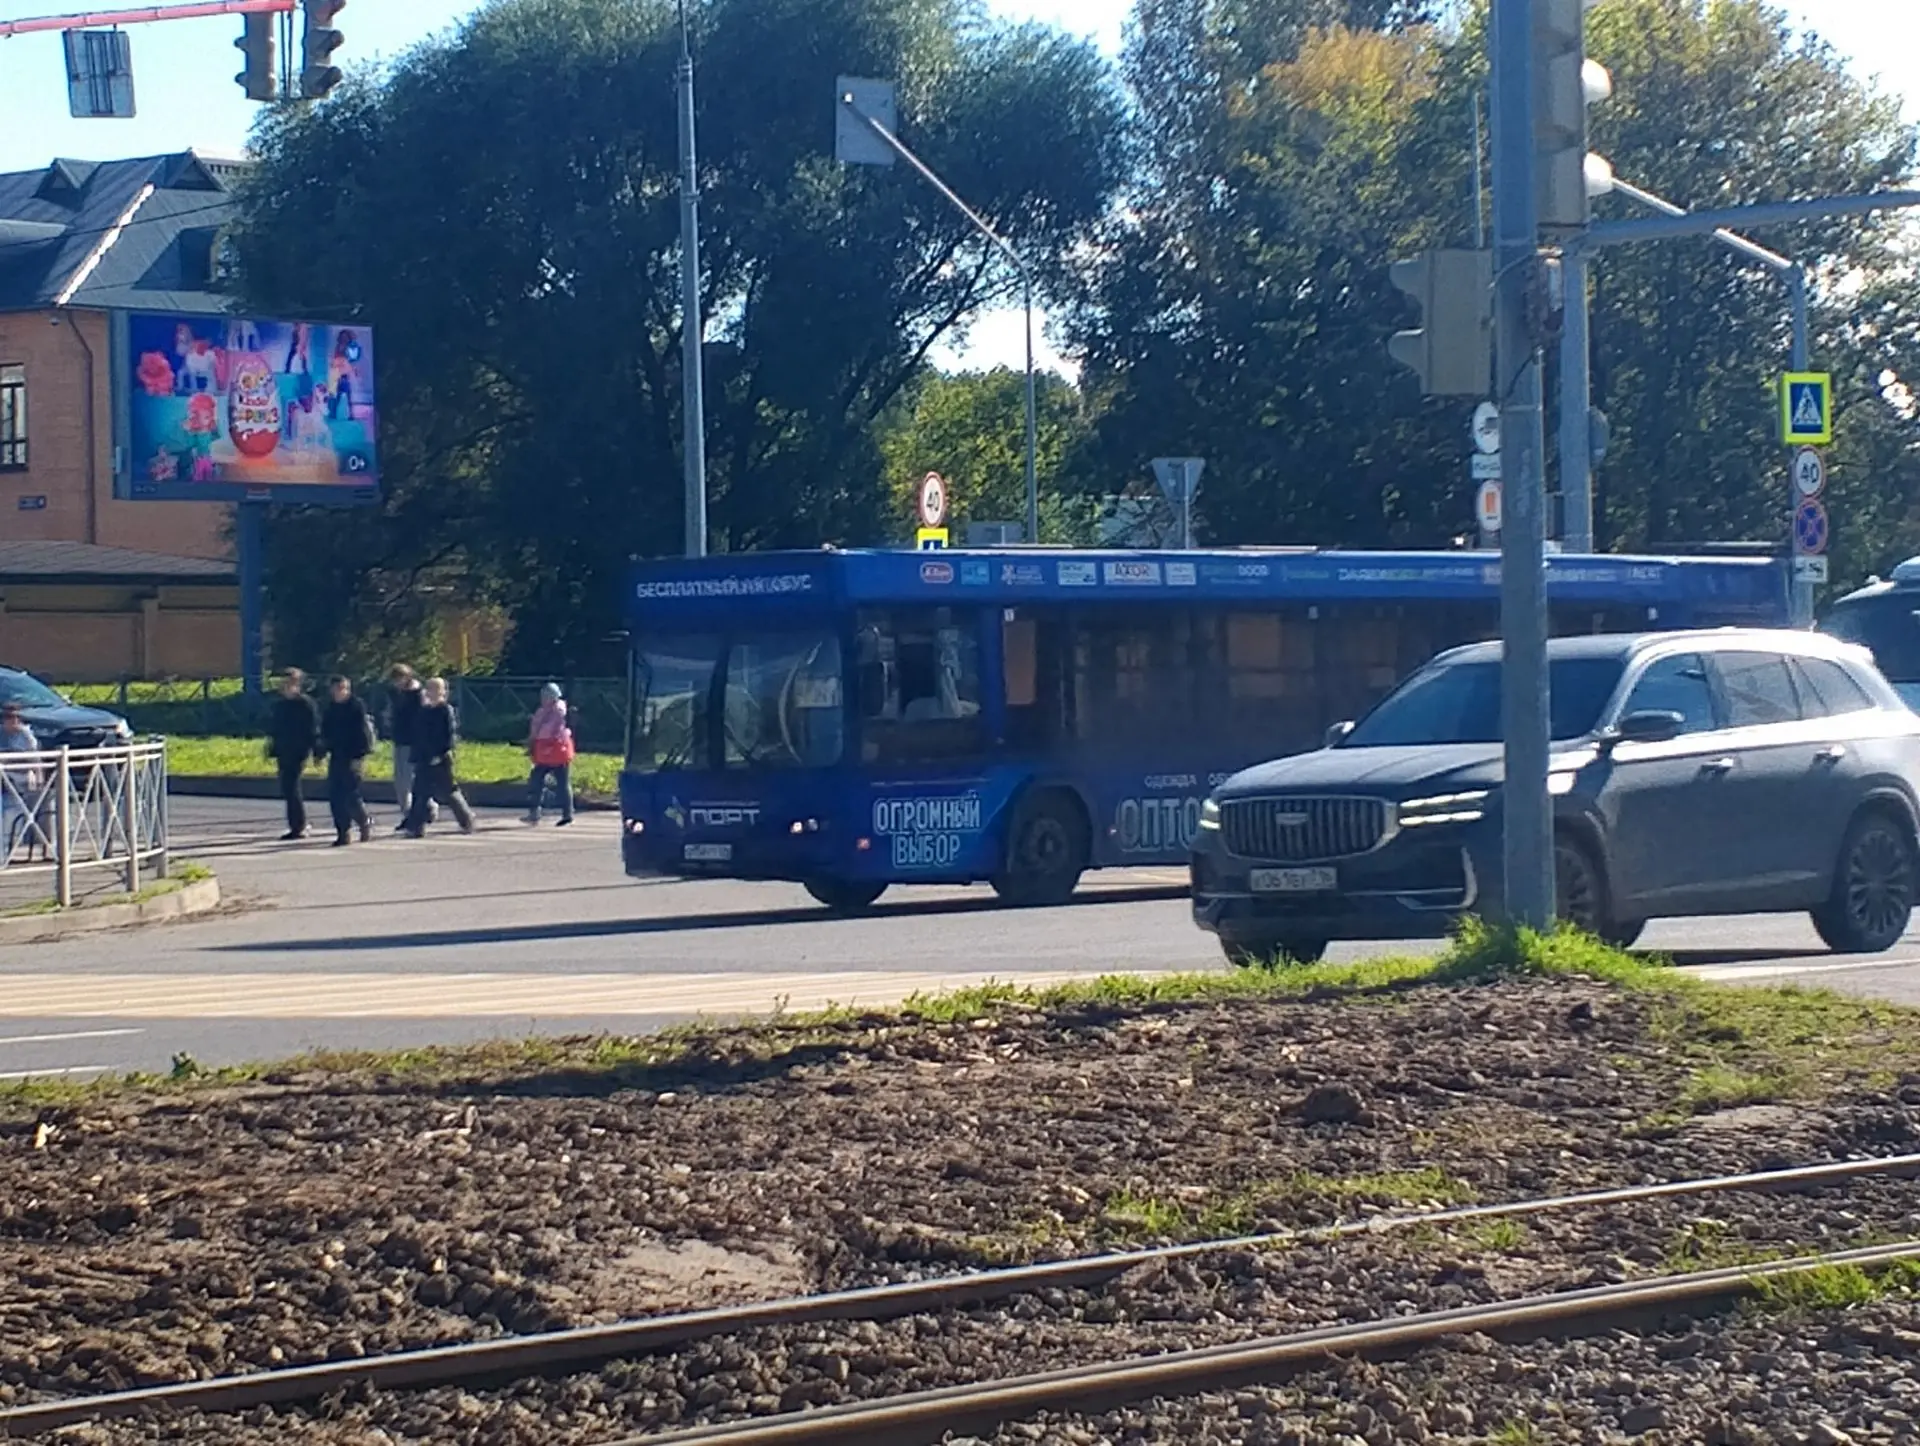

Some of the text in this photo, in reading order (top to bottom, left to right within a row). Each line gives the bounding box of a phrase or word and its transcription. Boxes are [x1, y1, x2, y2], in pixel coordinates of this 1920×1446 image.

[349, 456, 366, 471] 0+
[1800, 463, 1820, 484] 40
[926, 490, 940, 512] 40
[689, 808, 760, 826] ПОРТ
[874, 790, 982, 833] ОГРОМНЫЙ
[894, 833, 961, 865] ВЫБОР
